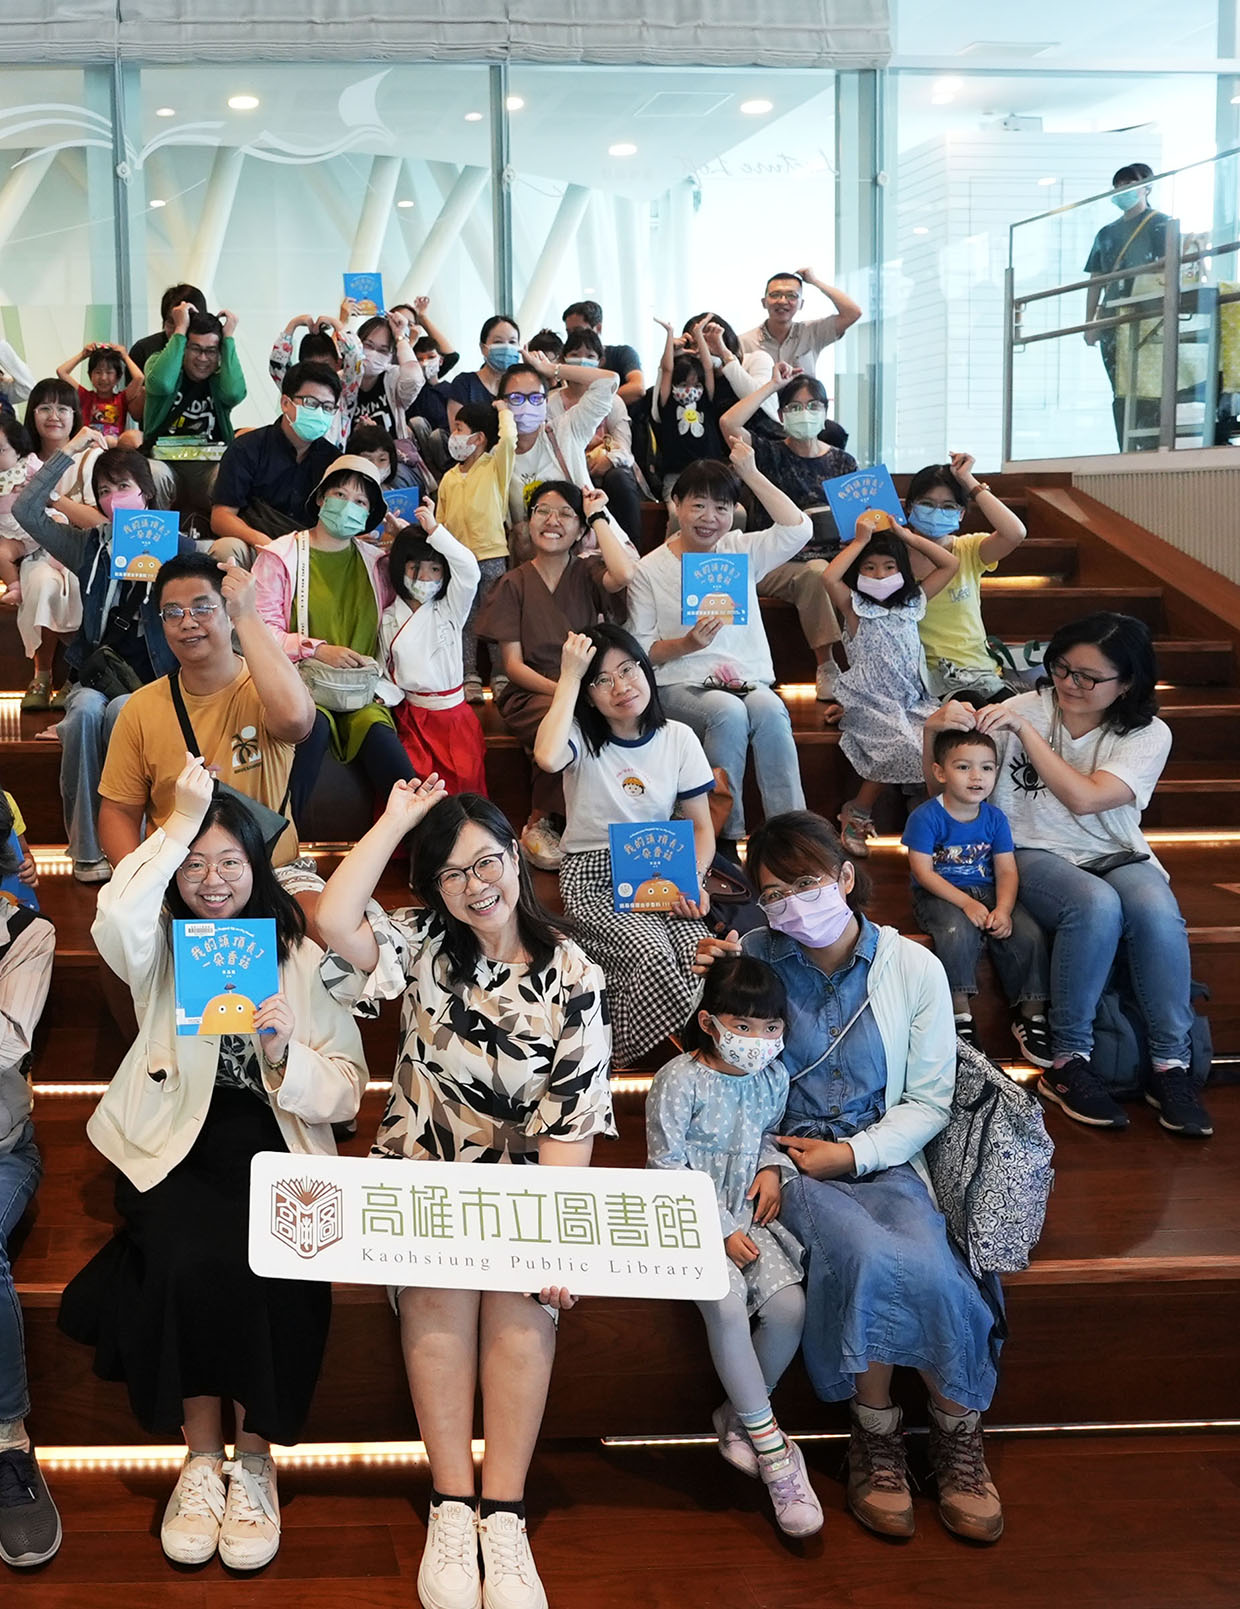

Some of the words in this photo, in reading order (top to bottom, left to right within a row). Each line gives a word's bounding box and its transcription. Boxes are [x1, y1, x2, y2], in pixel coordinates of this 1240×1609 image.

[361, 1182, 702, 1249] 高雄市立圖書館
[362, 1247, 491, 1271] Kaohsiung
[511, 1255, 590, 1273] Public
[610, 1259, 705, 1280] Library
